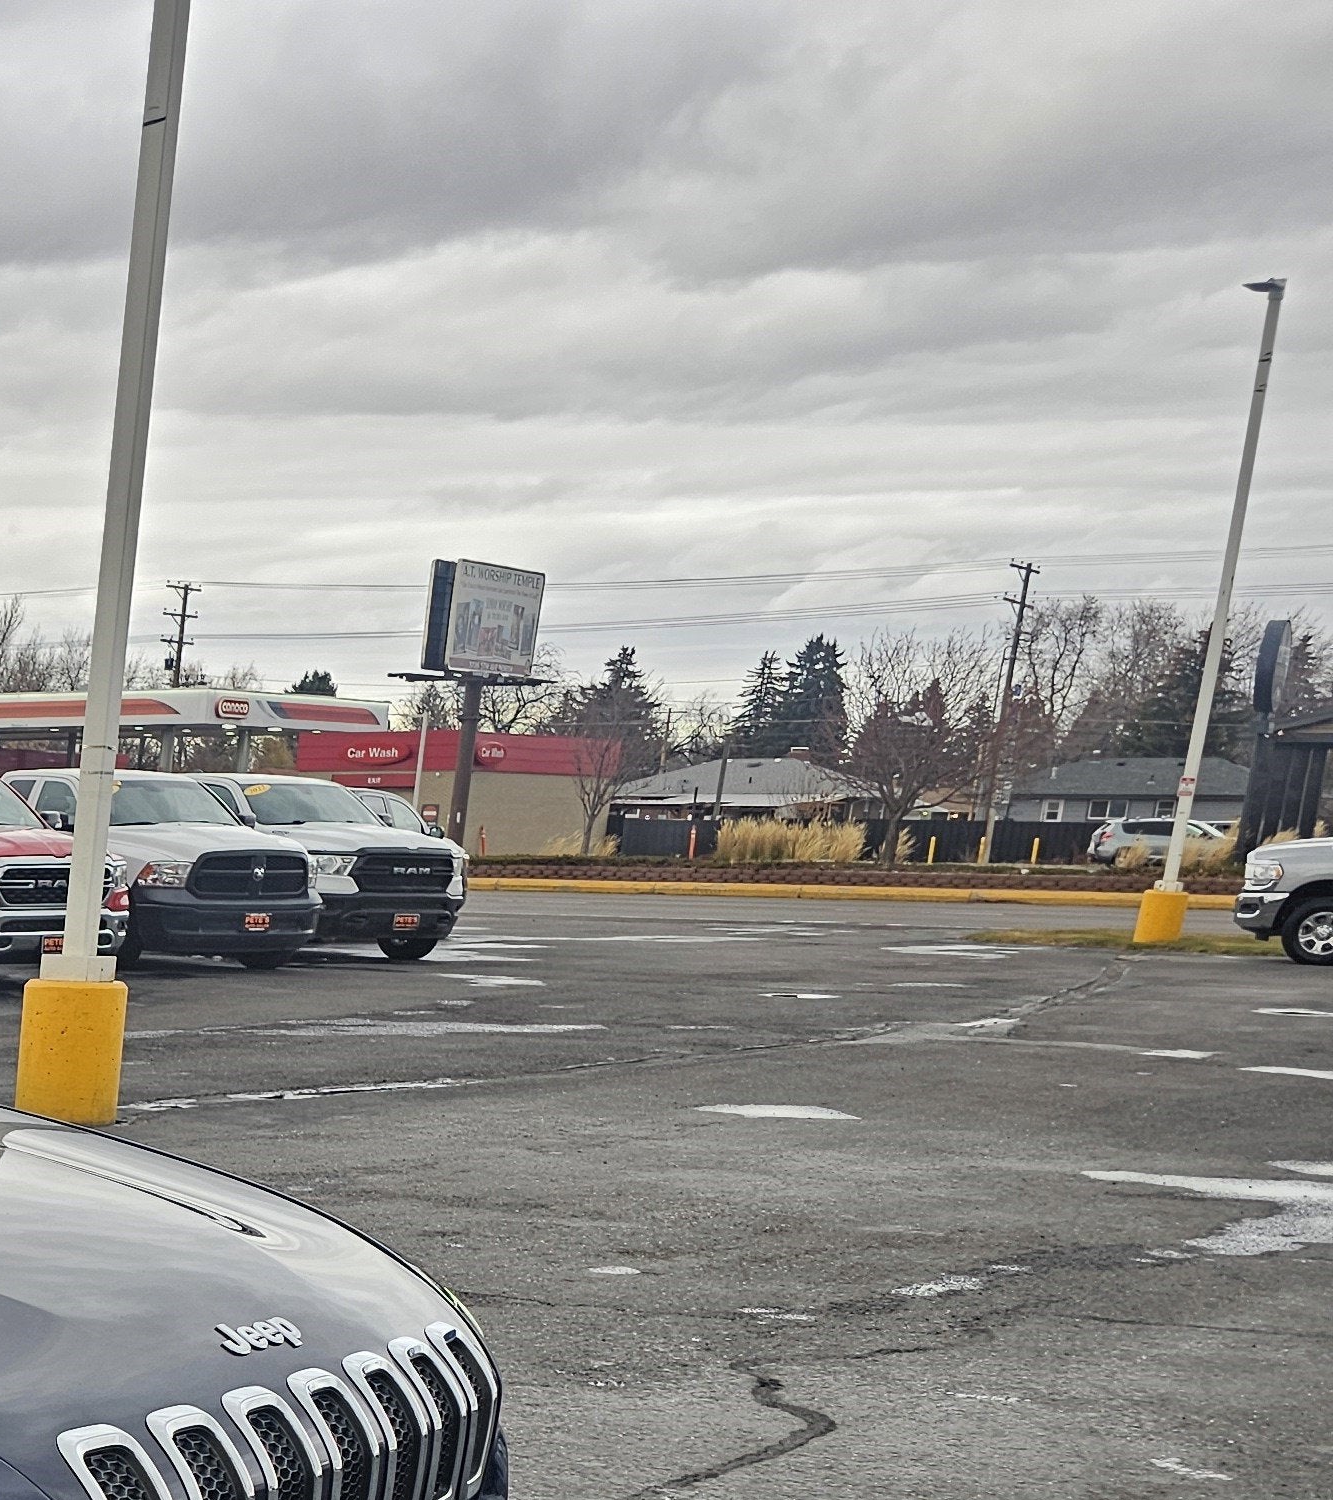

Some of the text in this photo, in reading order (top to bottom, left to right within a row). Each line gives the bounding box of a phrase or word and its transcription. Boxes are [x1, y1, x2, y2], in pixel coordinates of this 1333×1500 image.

[478, 566, 513, 584] WORSHIP
[513, 573, 541, 590] TEMPLE
[347, 747, 399, 758] Car Wash
[393, 867, 431, 875] RAM
[37, 880, 68, 888] RA
[214, 1316, 304, 1356] Jeep
